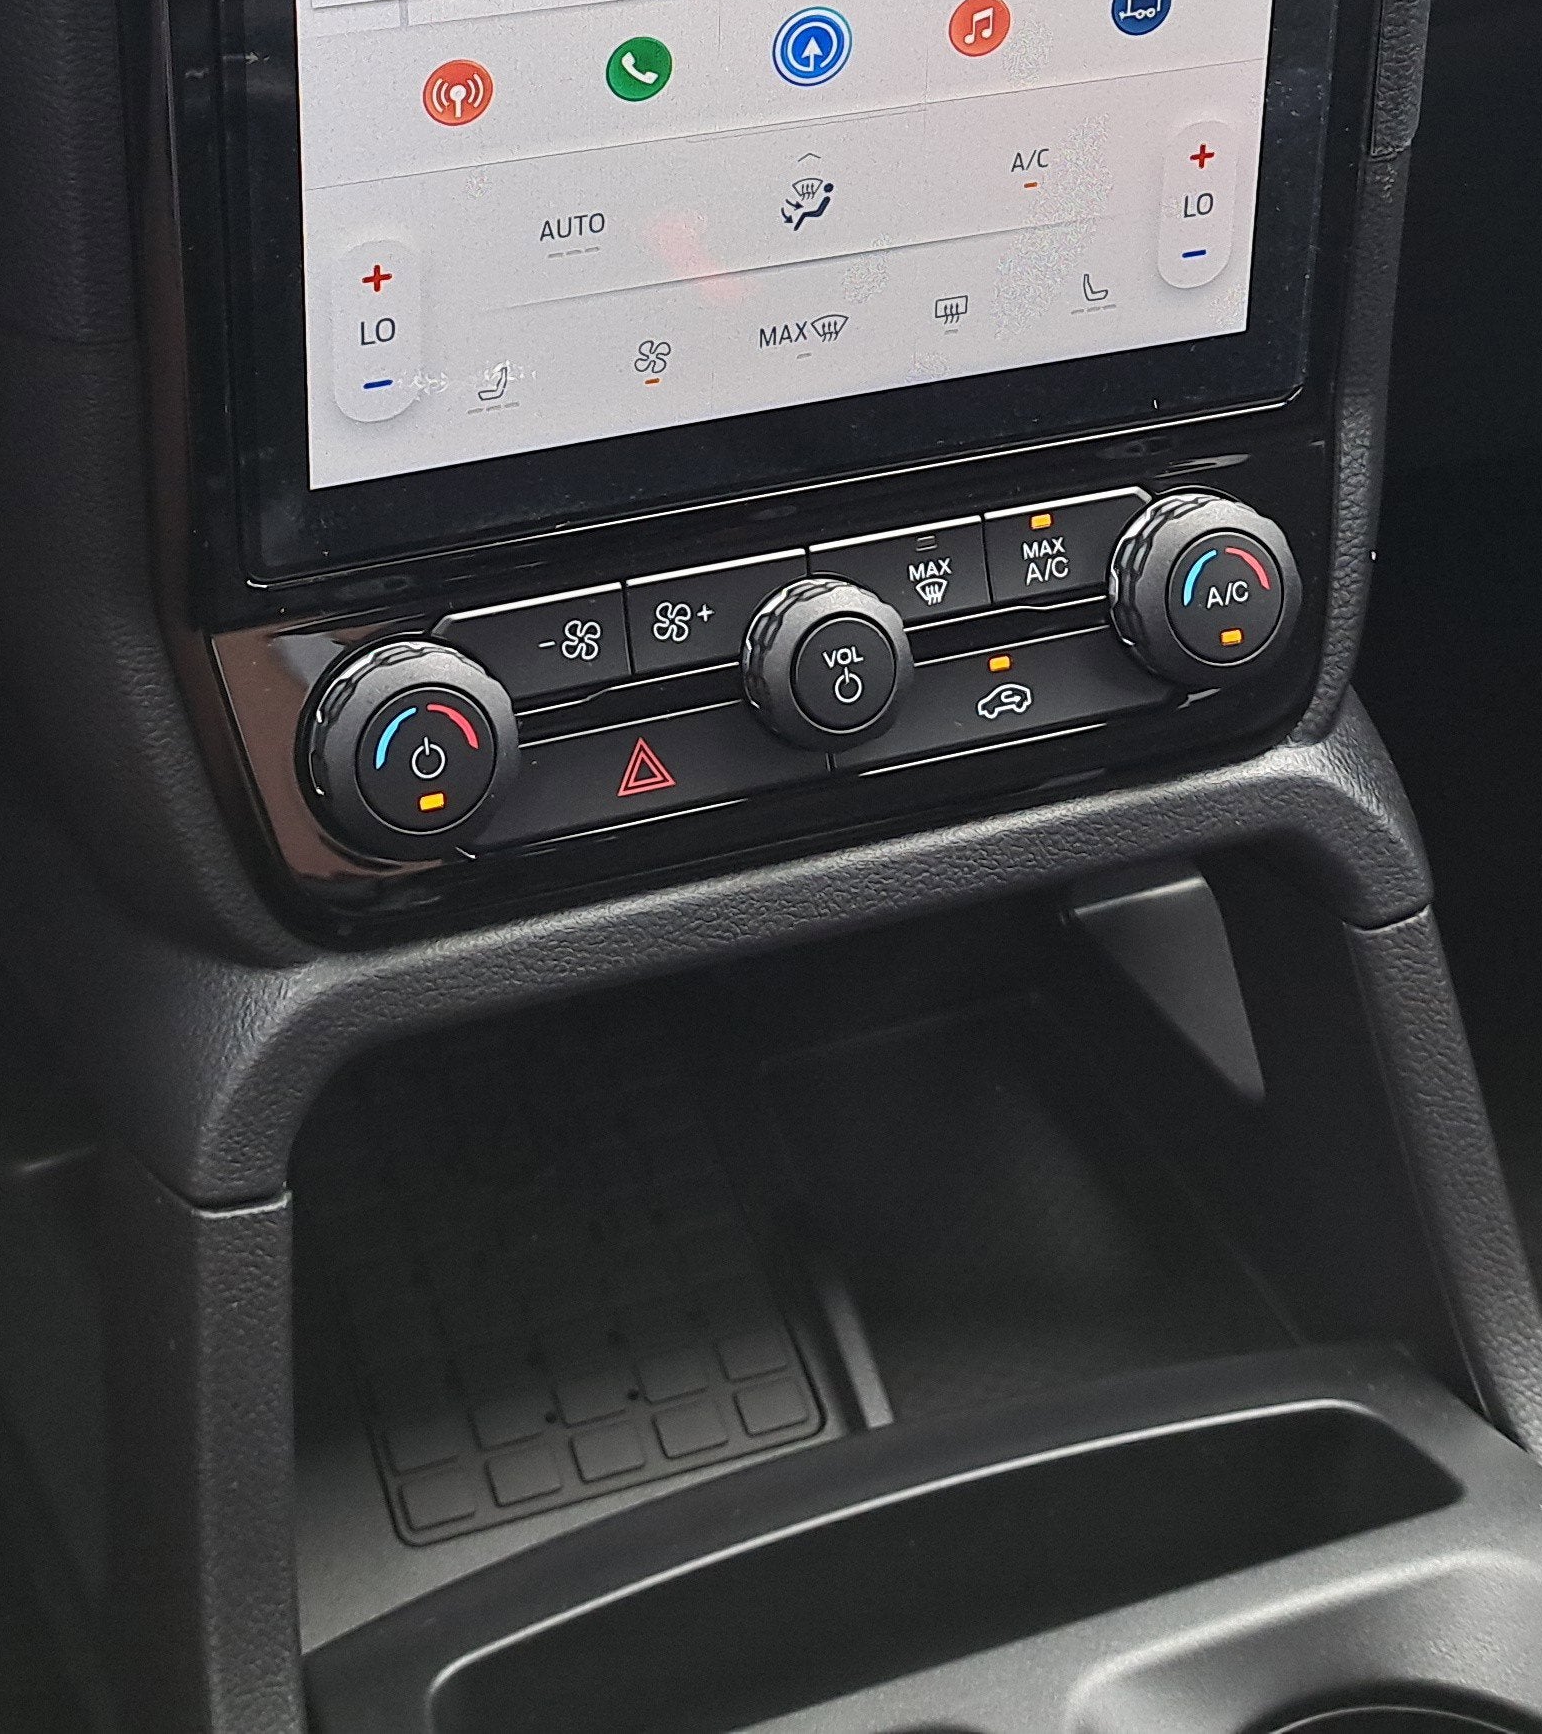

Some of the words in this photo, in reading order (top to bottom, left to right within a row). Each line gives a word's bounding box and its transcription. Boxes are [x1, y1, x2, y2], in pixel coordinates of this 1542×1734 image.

[1011, 148, 1050, 173] A/C
[1183, 192, 1215, 219] LO
[539, 212, 606, 242] AUTO
[360, 317, 396, 346] LO
[759, 321, 808, 350] MAX
[1023, 536, 1065, 561] MAX
[909, 558, 951, 583] MAX
[1026, 556, 1070, 586] A/C
[1206, 581, 1249, 608] A/C
[823, 646, 864, 668] VOL
